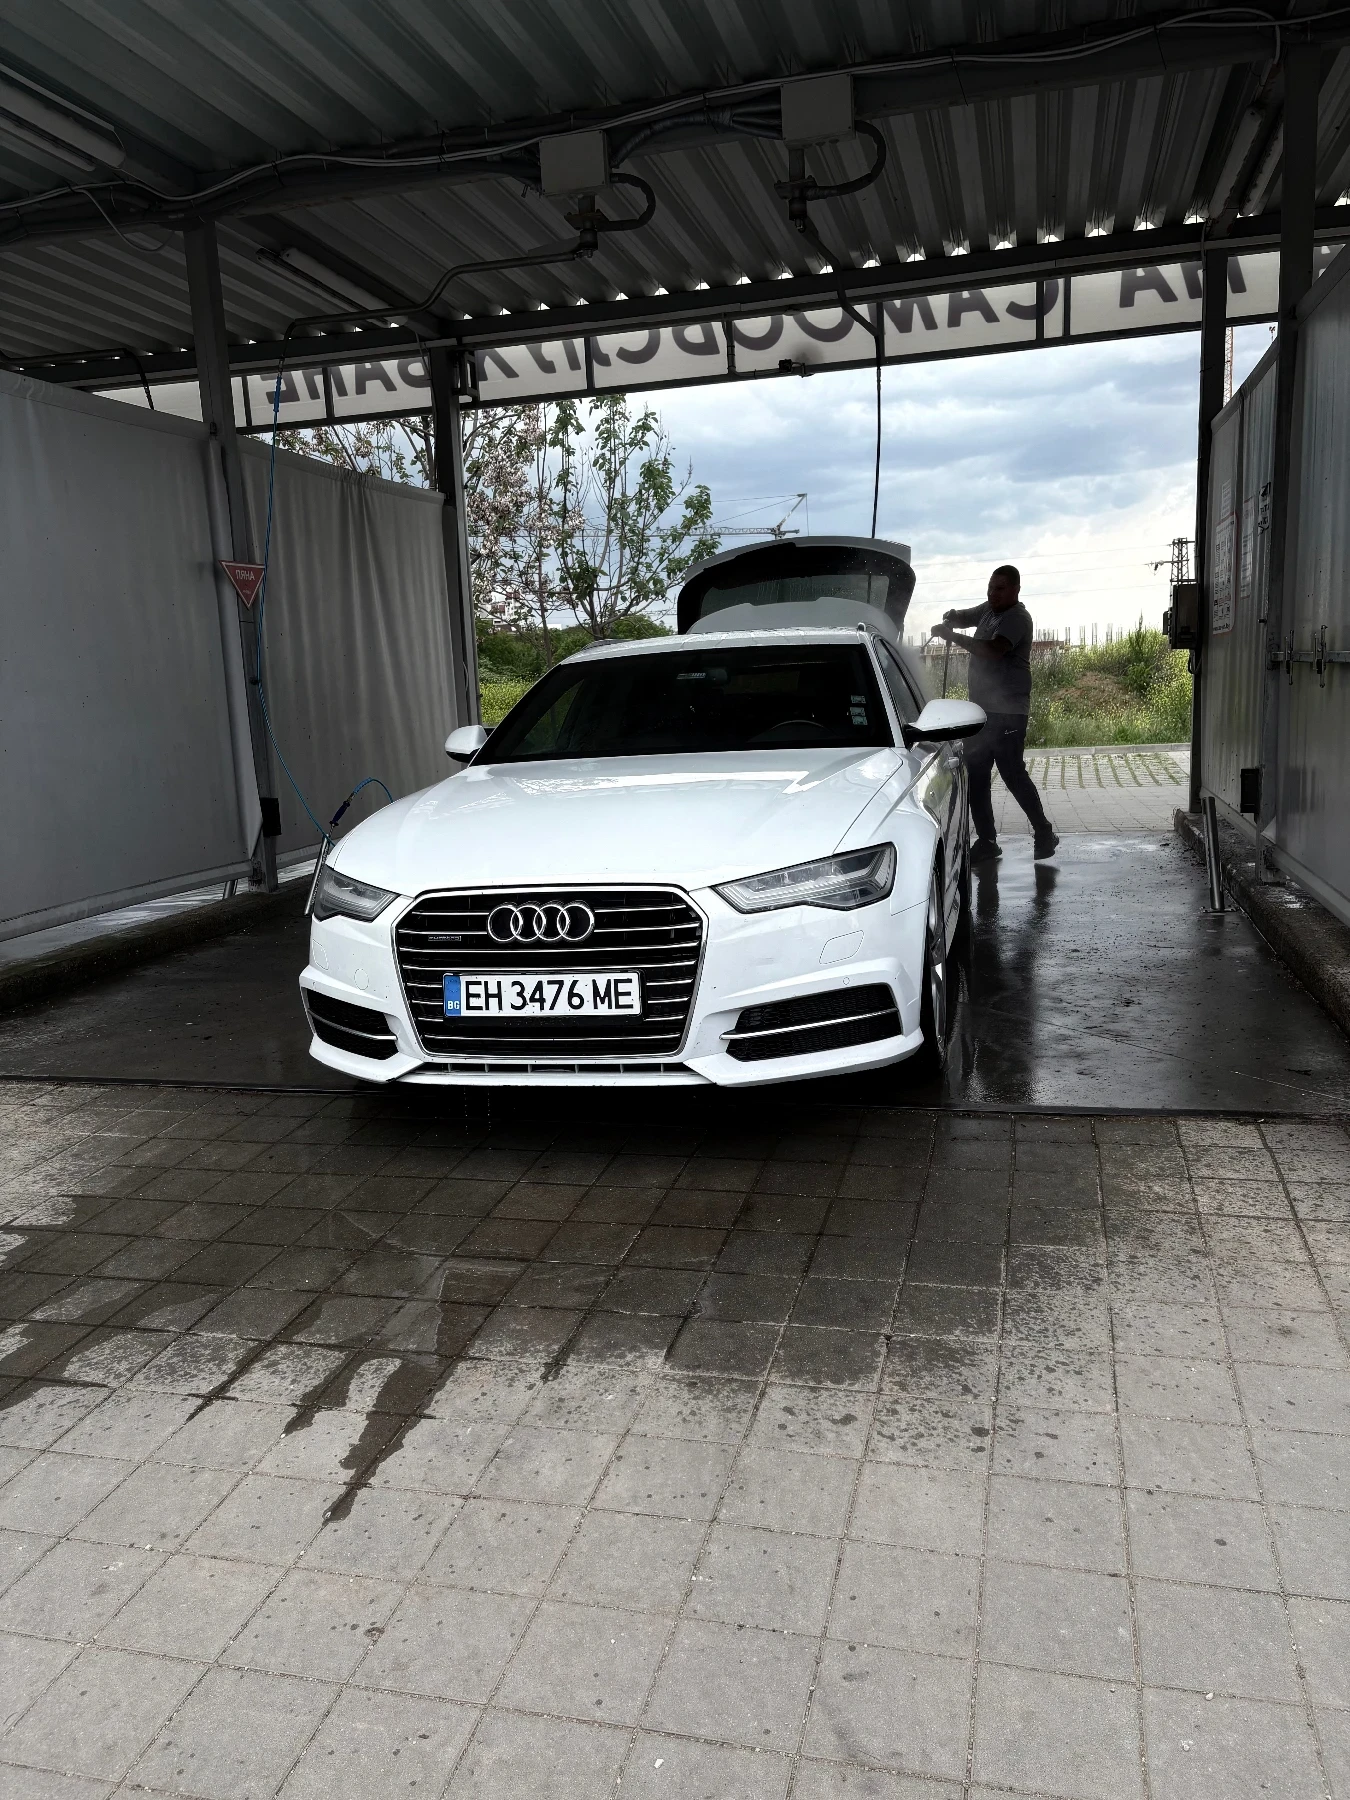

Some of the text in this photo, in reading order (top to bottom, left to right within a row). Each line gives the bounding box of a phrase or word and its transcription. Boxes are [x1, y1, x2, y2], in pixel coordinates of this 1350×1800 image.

[235, 569, 255, 581] ПЯНА
[465, 978, 634, 1011] EH 3476 ME
[447, 1000, 460, 1010] BG
